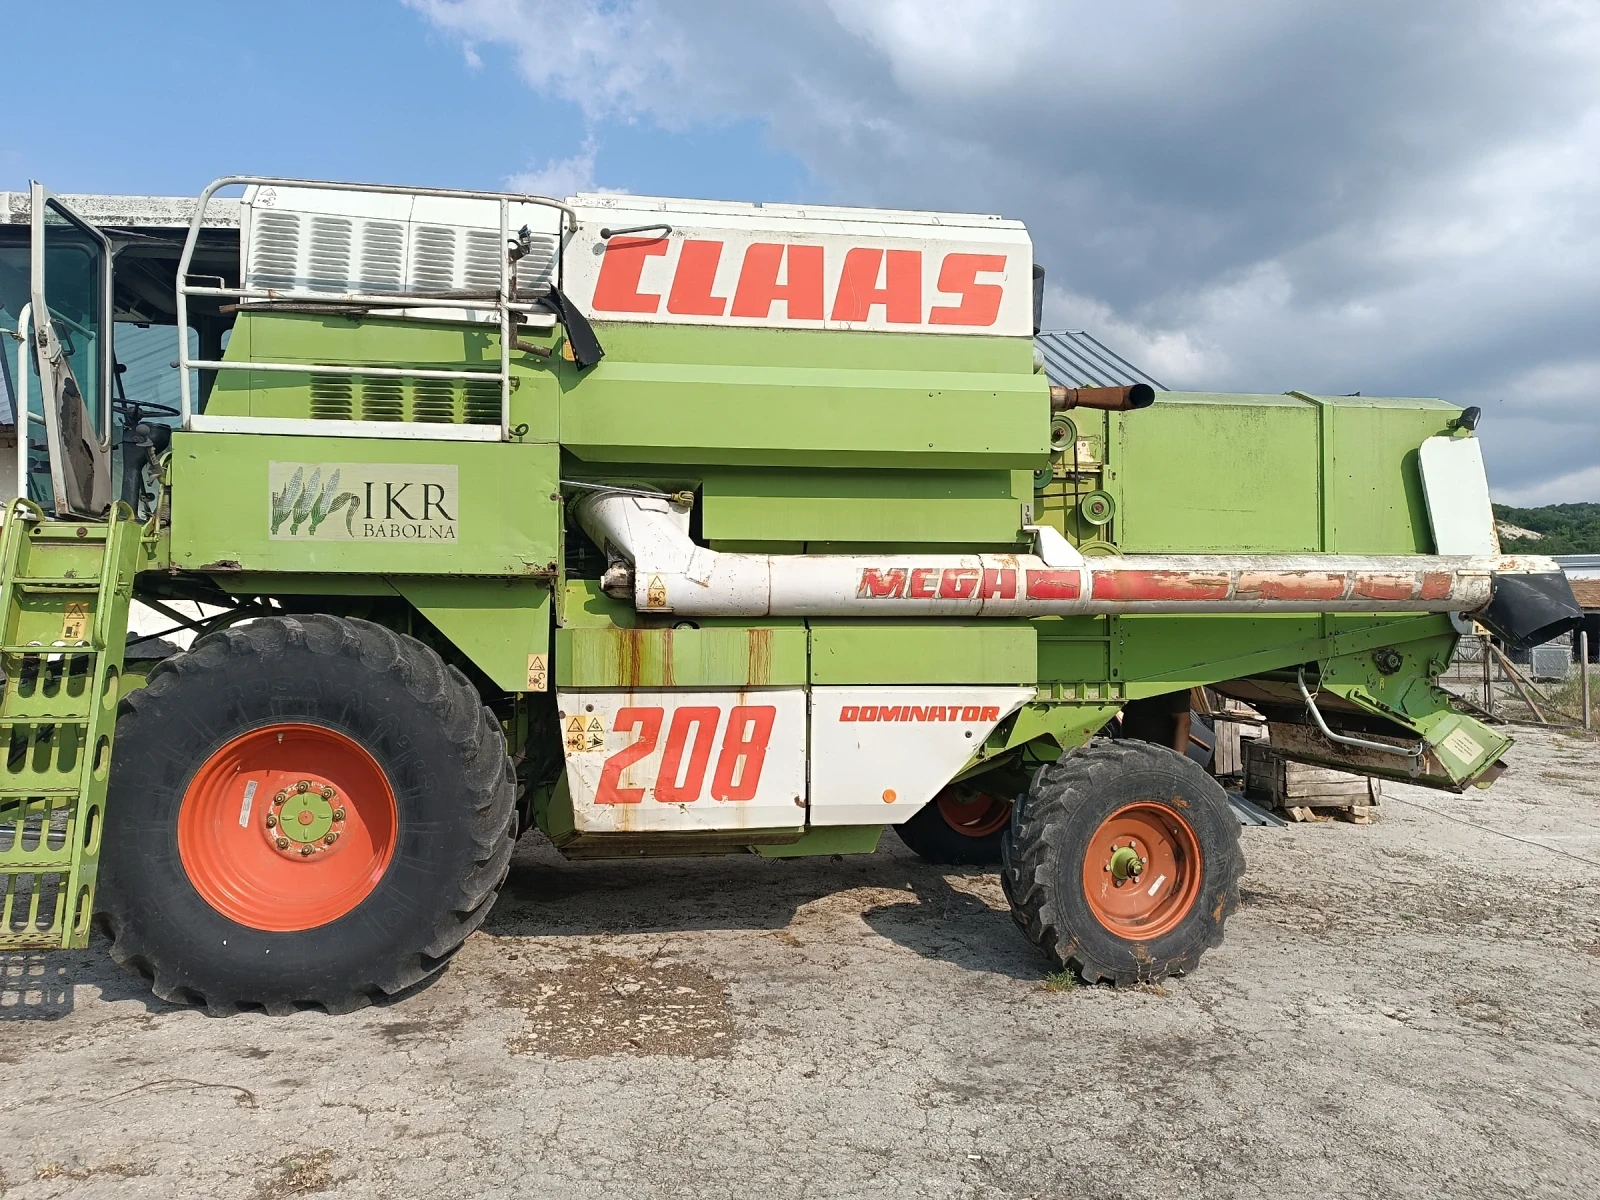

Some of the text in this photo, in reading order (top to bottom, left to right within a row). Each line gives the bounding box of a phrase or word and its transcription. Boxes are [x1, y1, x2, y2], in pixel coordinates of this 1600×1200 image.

[592, 235, 1008, 326] CLAAS
[363, 481, 457, 521] IKR
[856, 568, 1017, 600] MEGA
[839, 705, 1000, 722] DOMINATOR
[594, 705, 777, 805] 208
